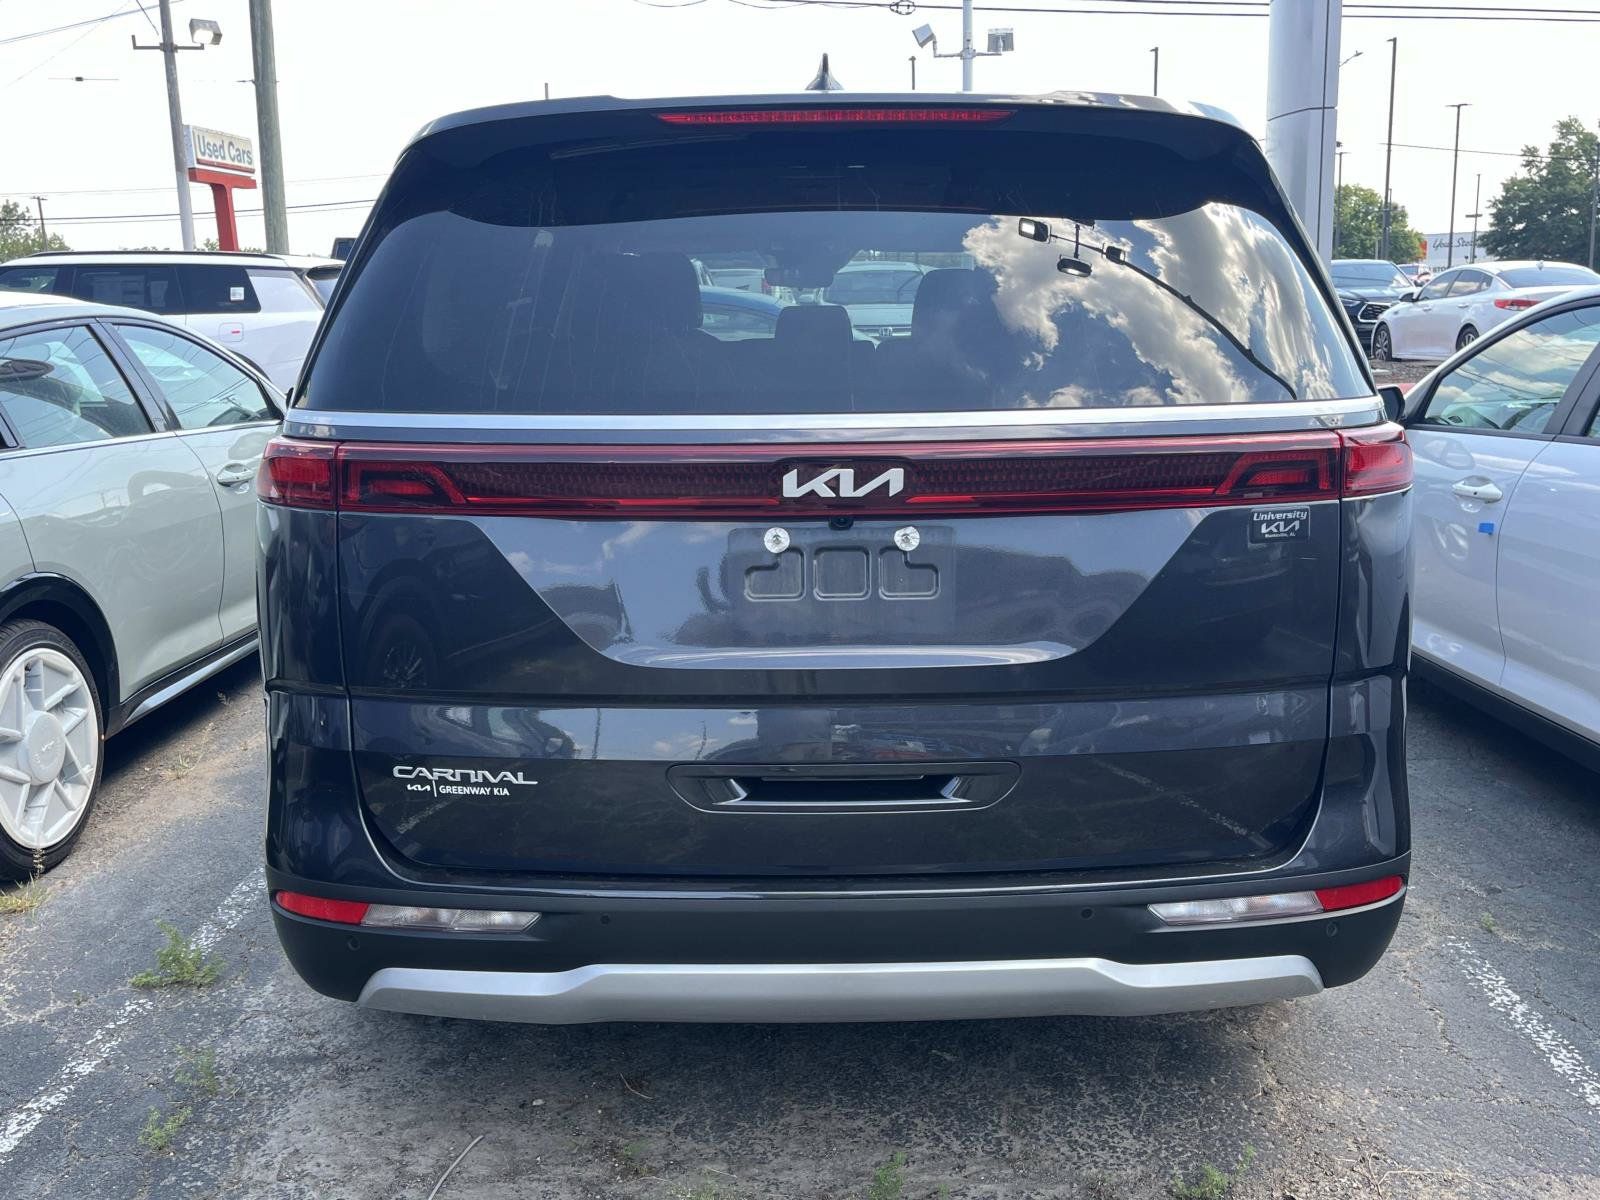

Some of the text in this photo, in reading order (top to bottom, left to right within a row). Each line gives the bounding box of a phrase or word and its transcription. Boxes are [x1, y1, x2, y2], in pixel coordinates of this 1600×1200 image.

[197, 134, 253, 165] Used Cars
[782, 468, 904, 498] KIA
[1253, 511, 1307, 521] University
[1261, 520, 1300, 533] KIA
[392, 765, 538, 785] CARNIVAL
[439, 785, 510, 796] GREENWAY KIA
